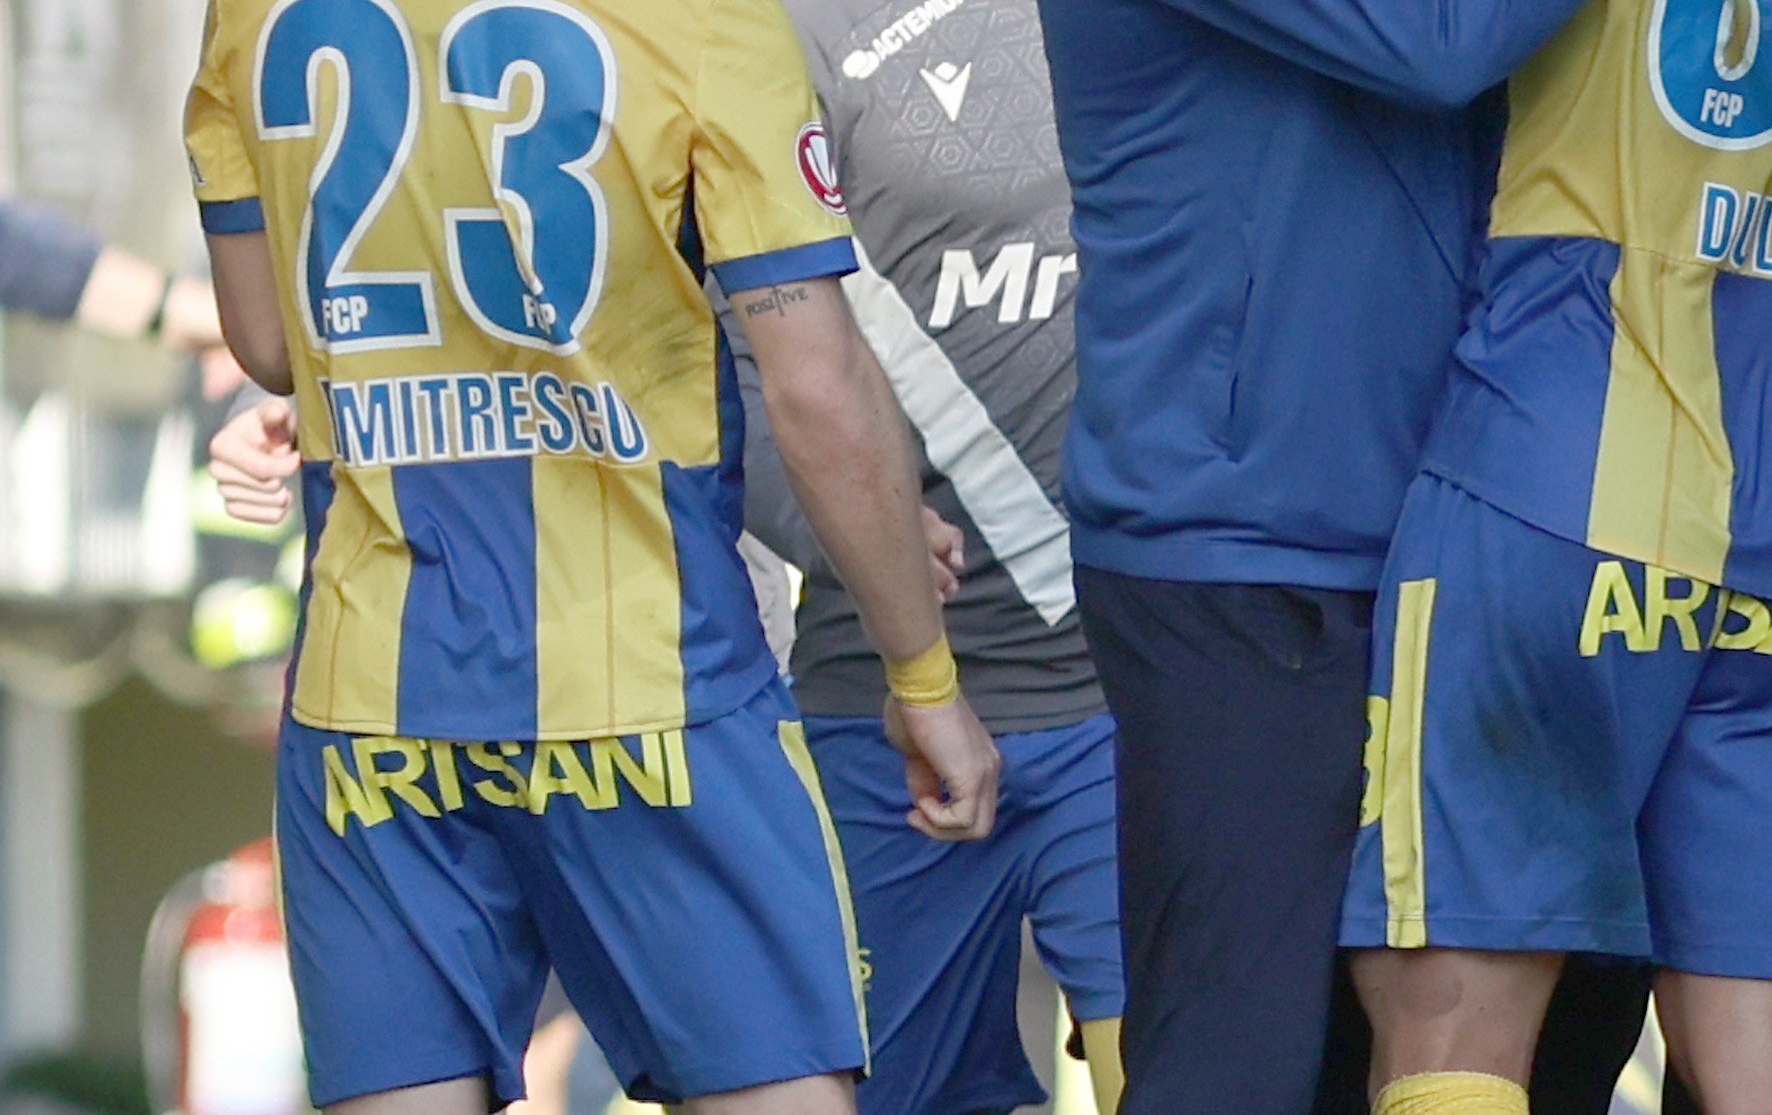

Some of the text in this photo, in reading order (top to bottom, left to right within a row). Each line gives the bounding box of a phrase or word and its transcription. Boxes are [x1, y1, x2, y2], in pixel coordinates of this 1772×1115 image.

[1700, 88, 1744, 128] FCP
[321, 295, 369, 334] FCP
[318, 371, 650, 468] MITRESCU
